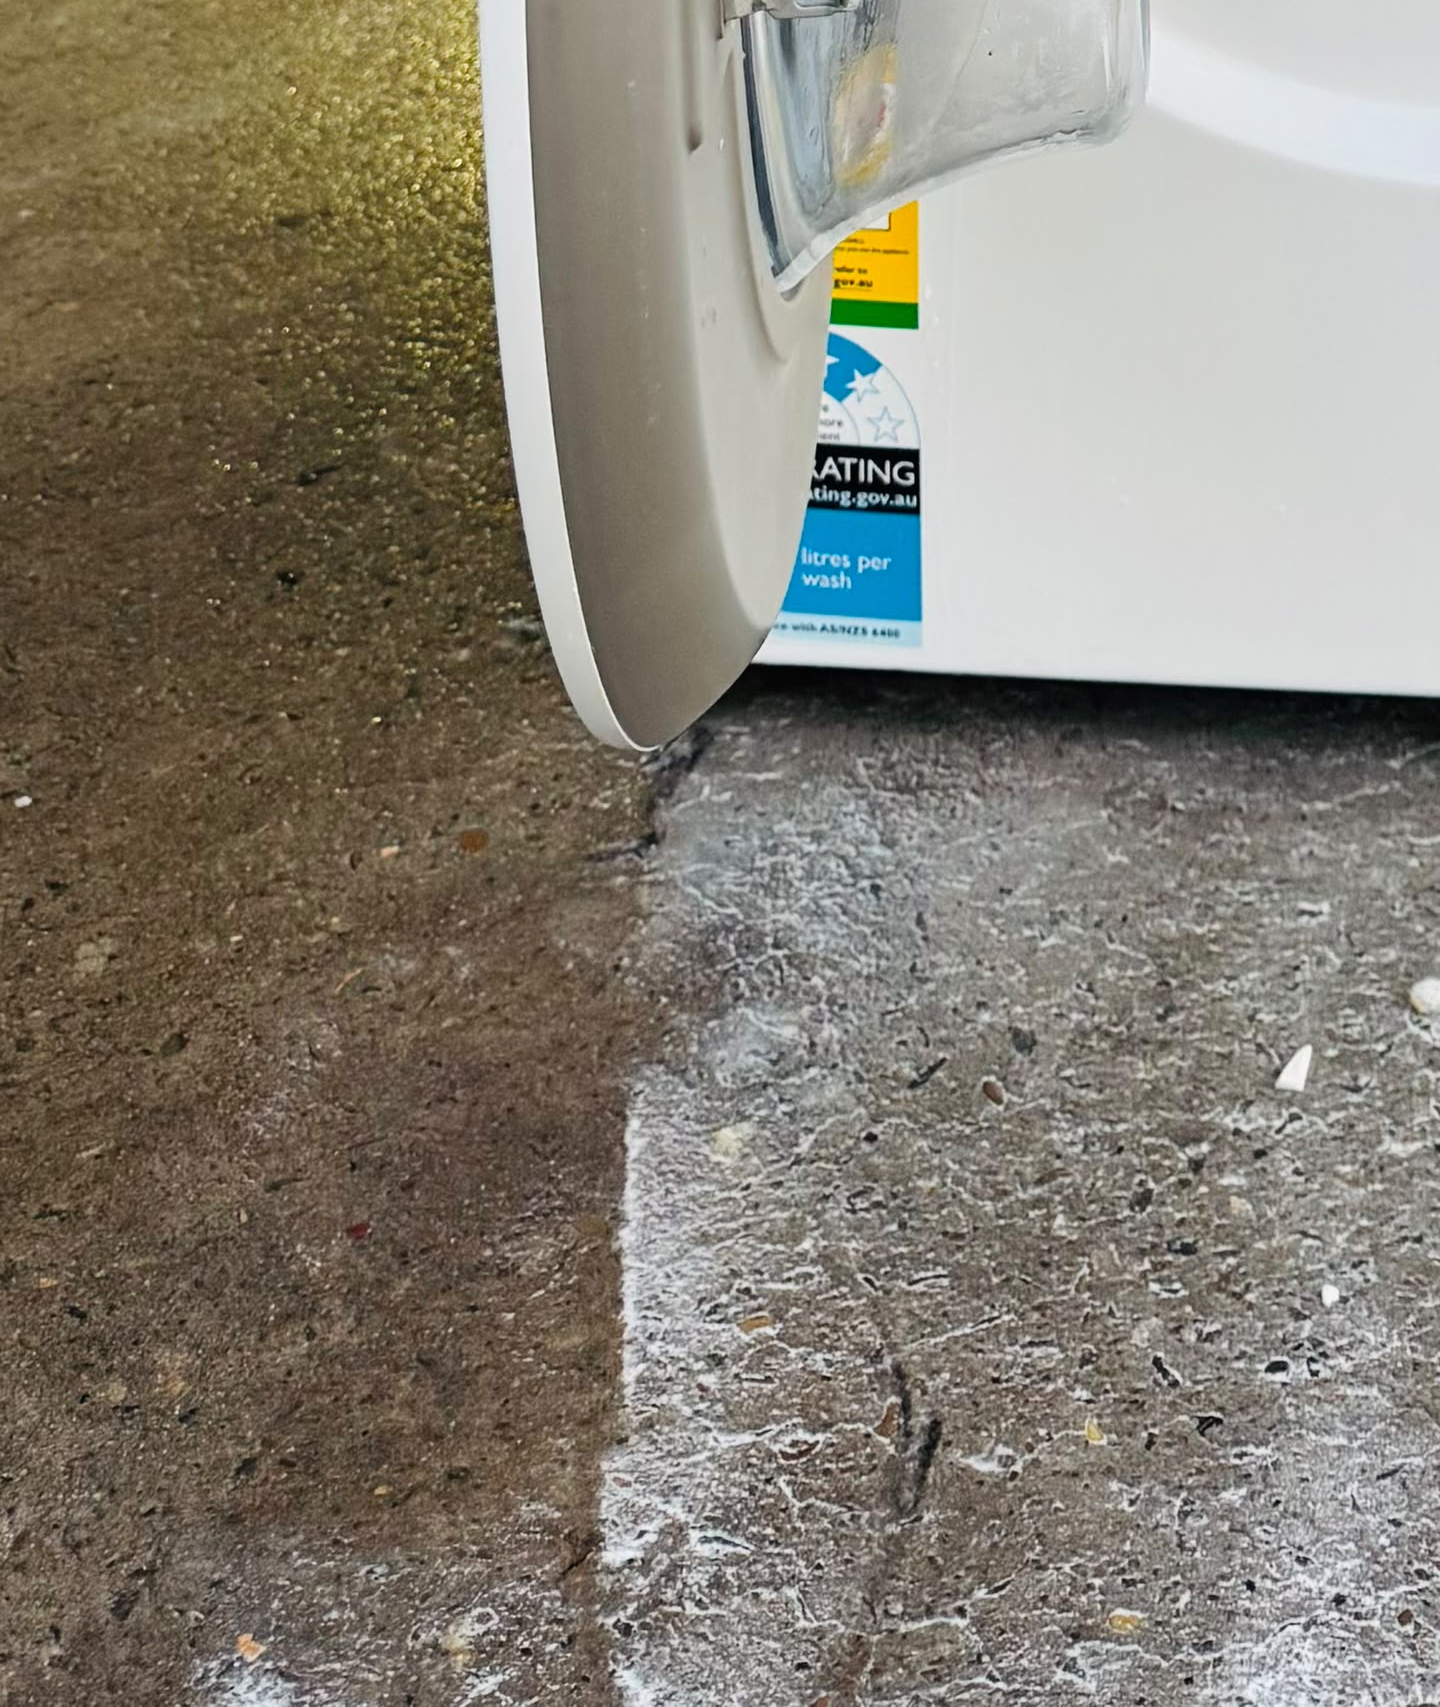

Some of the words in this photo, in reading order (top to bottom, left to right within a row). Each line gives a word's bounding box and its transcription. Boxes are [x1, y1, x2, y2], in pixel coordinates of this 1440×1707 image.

[801, 546, 851, 569] litres
[857, 555, 892, 574] per
[801, 570, 852, 590] wash
